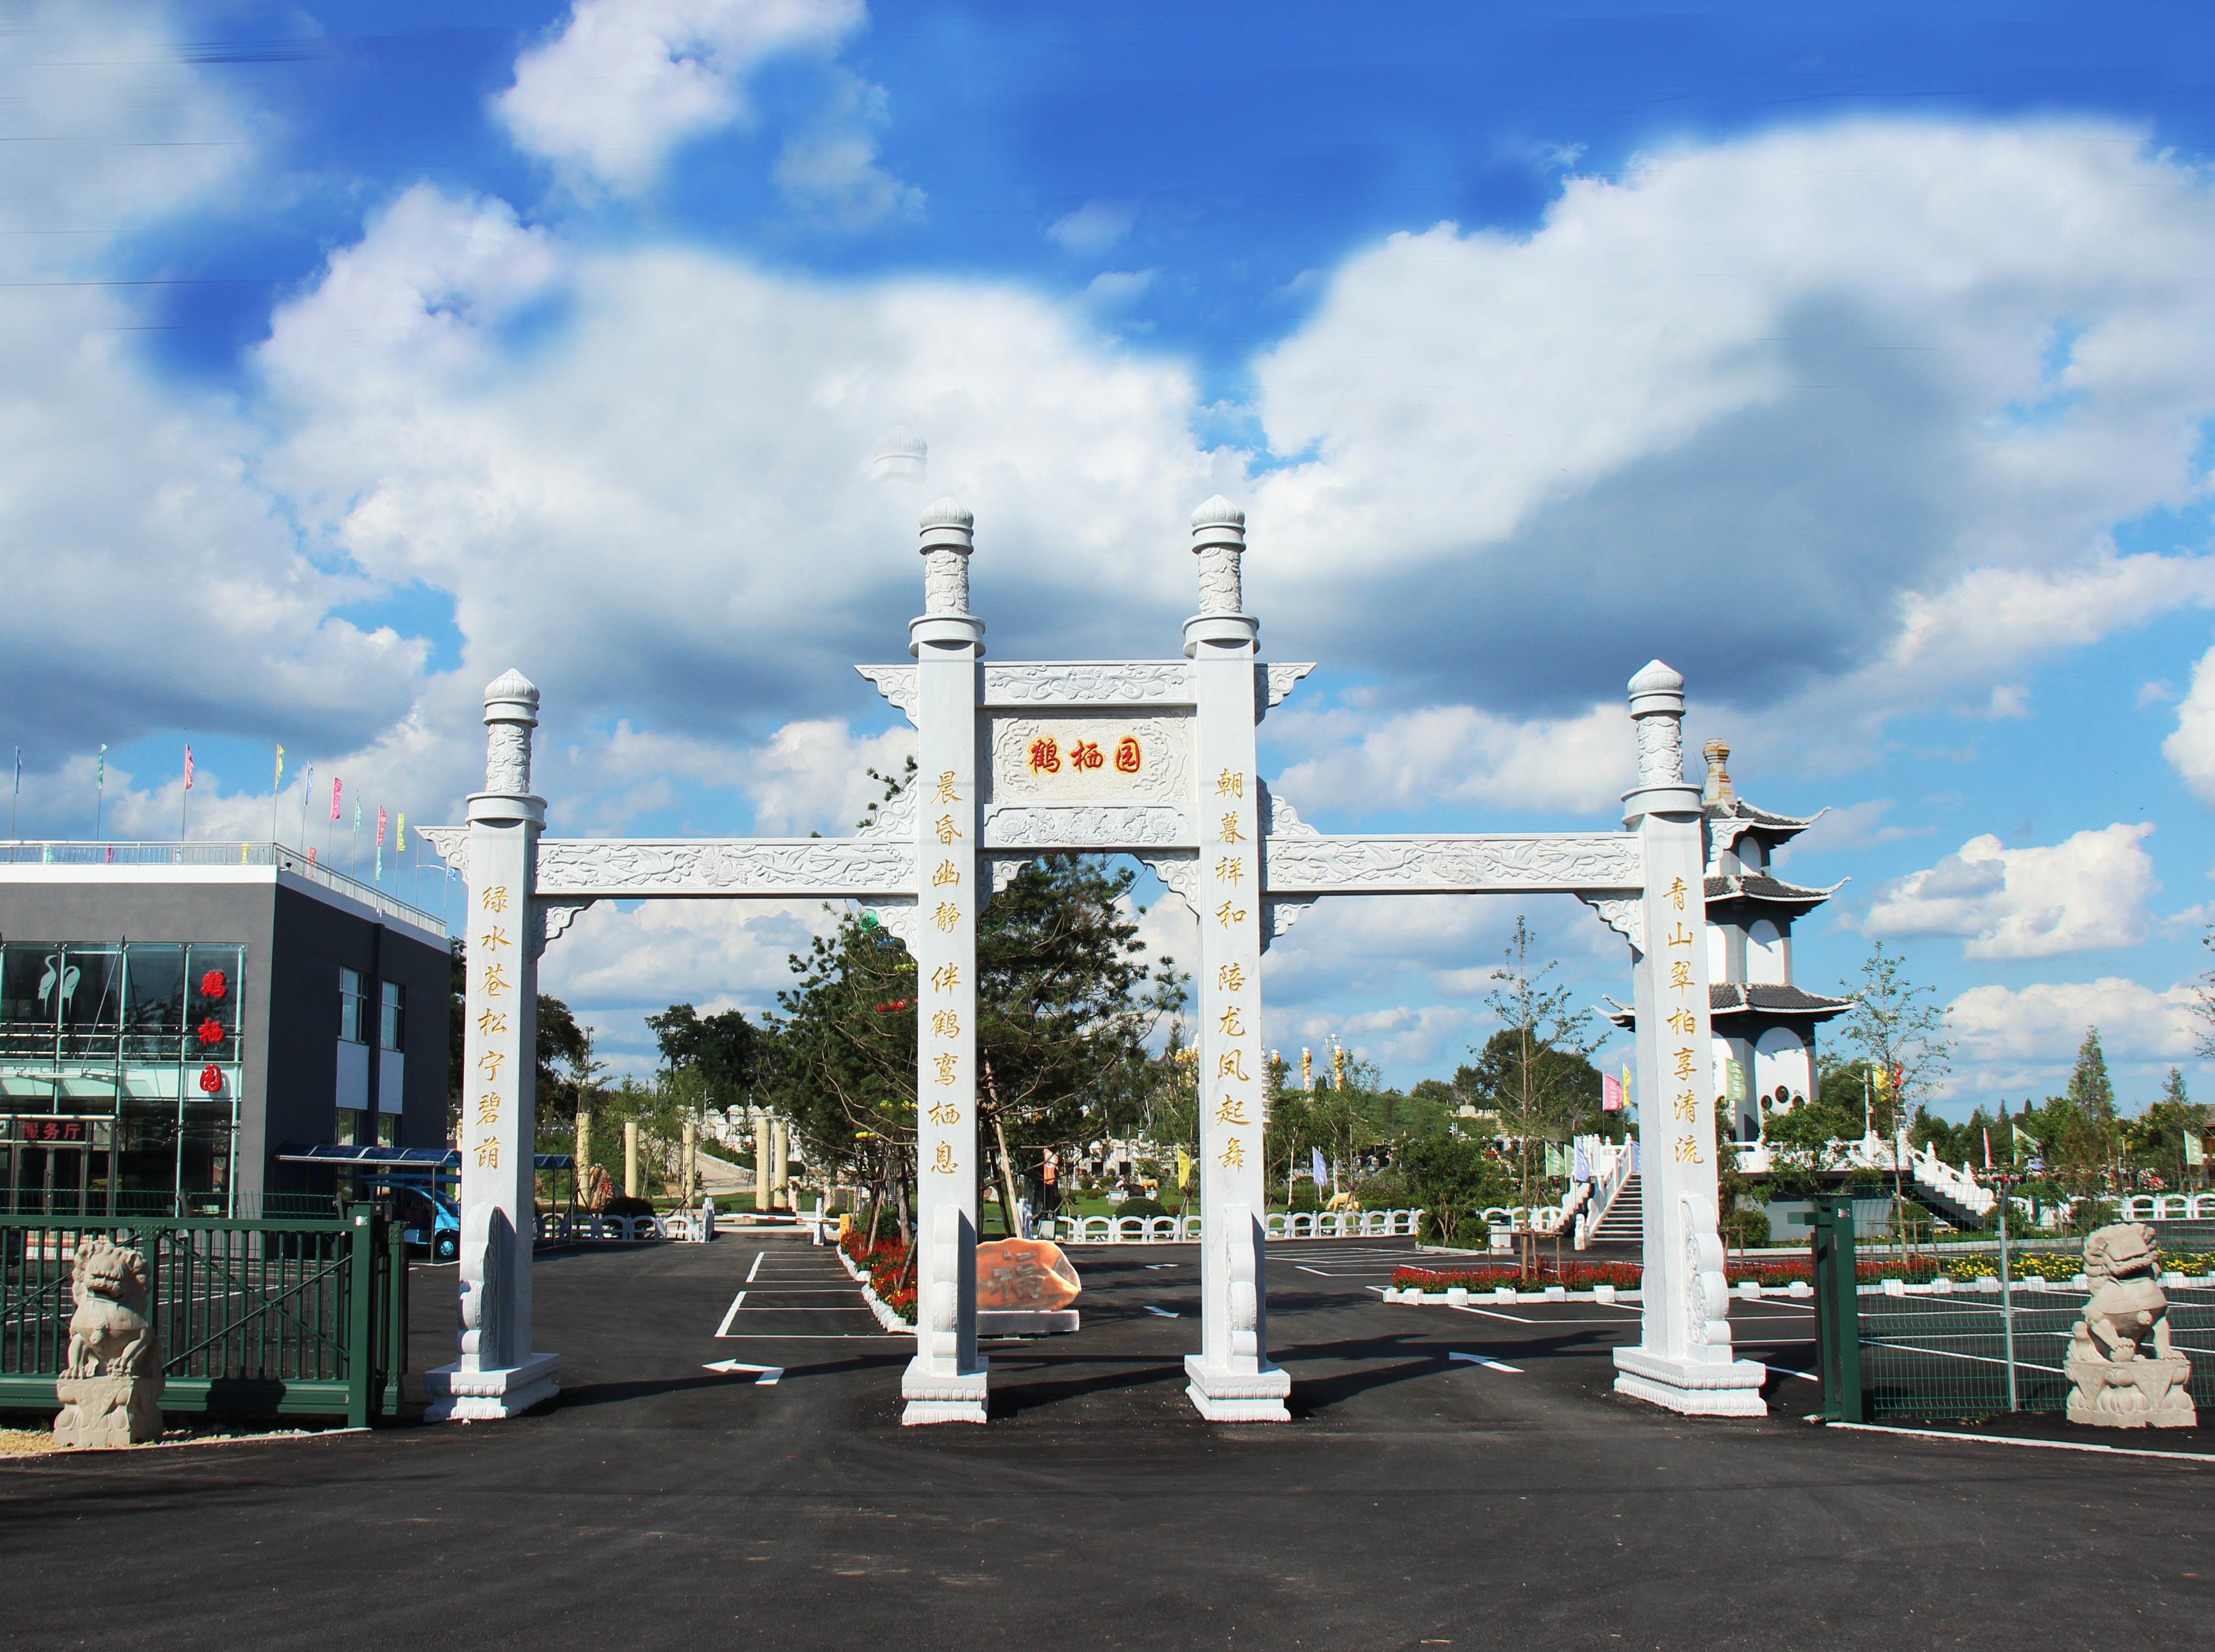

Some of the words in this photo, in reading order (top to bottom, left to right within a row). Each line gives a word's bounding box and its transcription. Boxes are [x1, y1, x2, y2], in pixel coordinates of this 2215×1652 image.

[1029, 737, 1143, 775] 鹤栖园
[198, 969, 227, 1093] 鹤栖园
[1663, 876, 1704, 1165] 青山翠柏享清流
[24, 1122, 80, 1140] 服务厅
[992, 1251, 1044, 1299] 福
